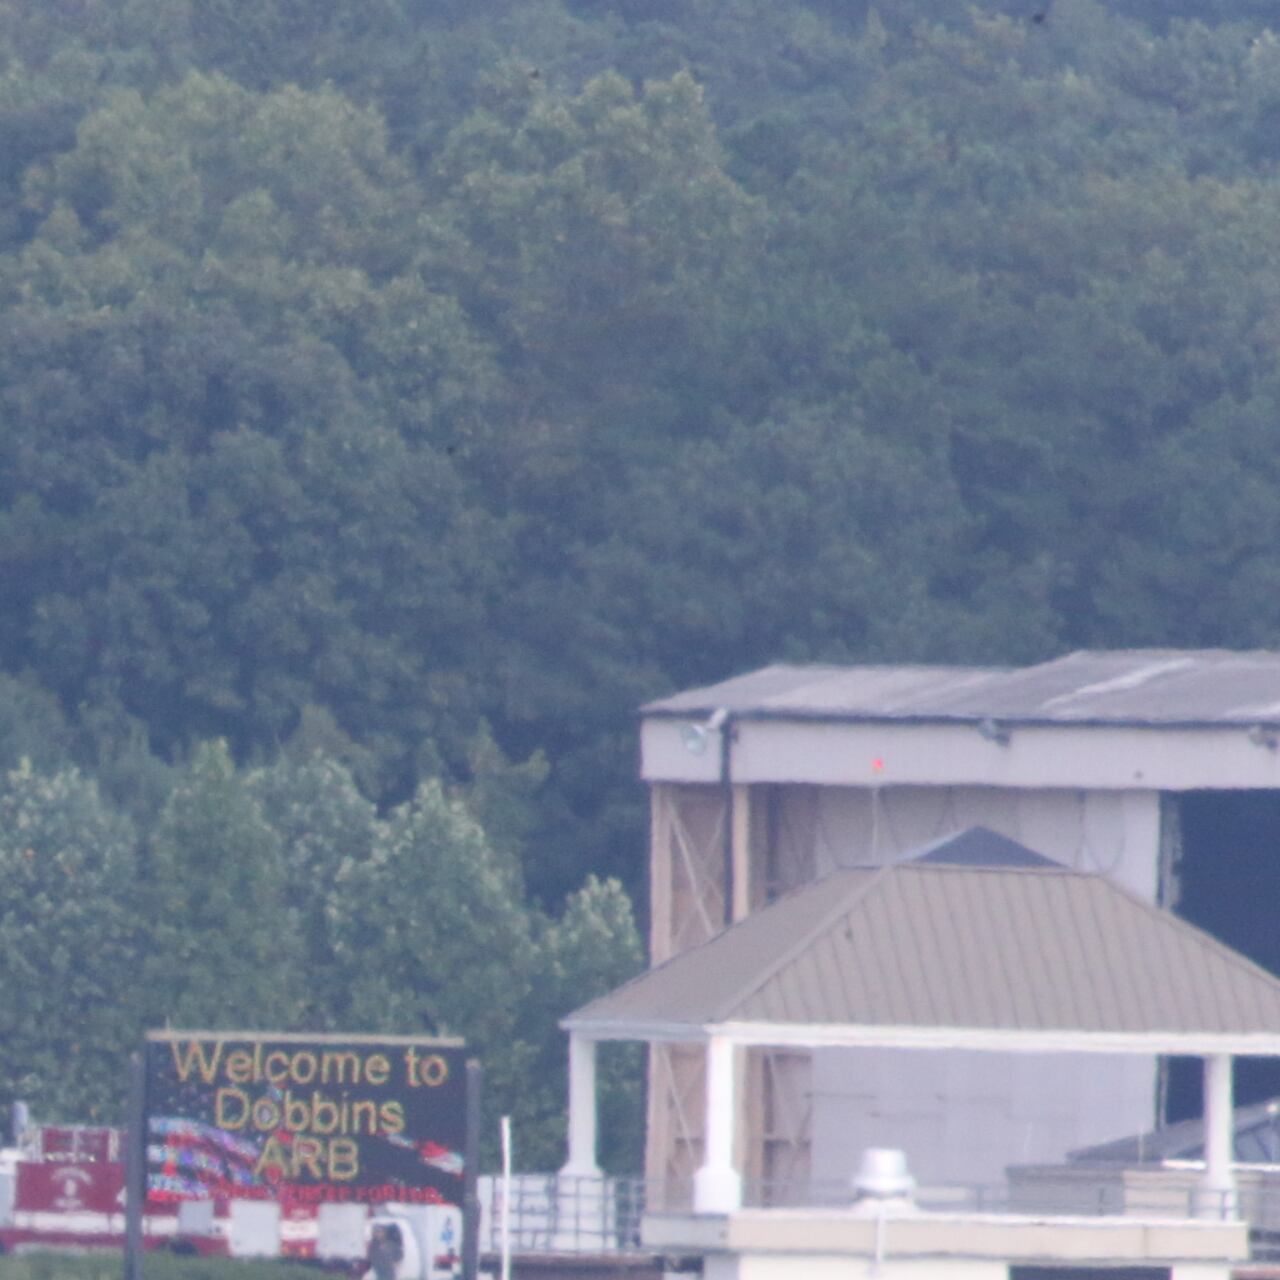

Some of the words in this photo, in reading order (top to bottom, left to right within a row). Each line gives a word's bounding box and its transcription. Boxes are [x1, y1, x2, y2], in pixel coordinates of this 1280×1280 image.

[170, 1040, 391, 1085] Welcome
[405, 1045, 449, 1088] to
[214, 1087, 407, 1135] Dobbins
[253, 1135, 360, 1181] ARB
